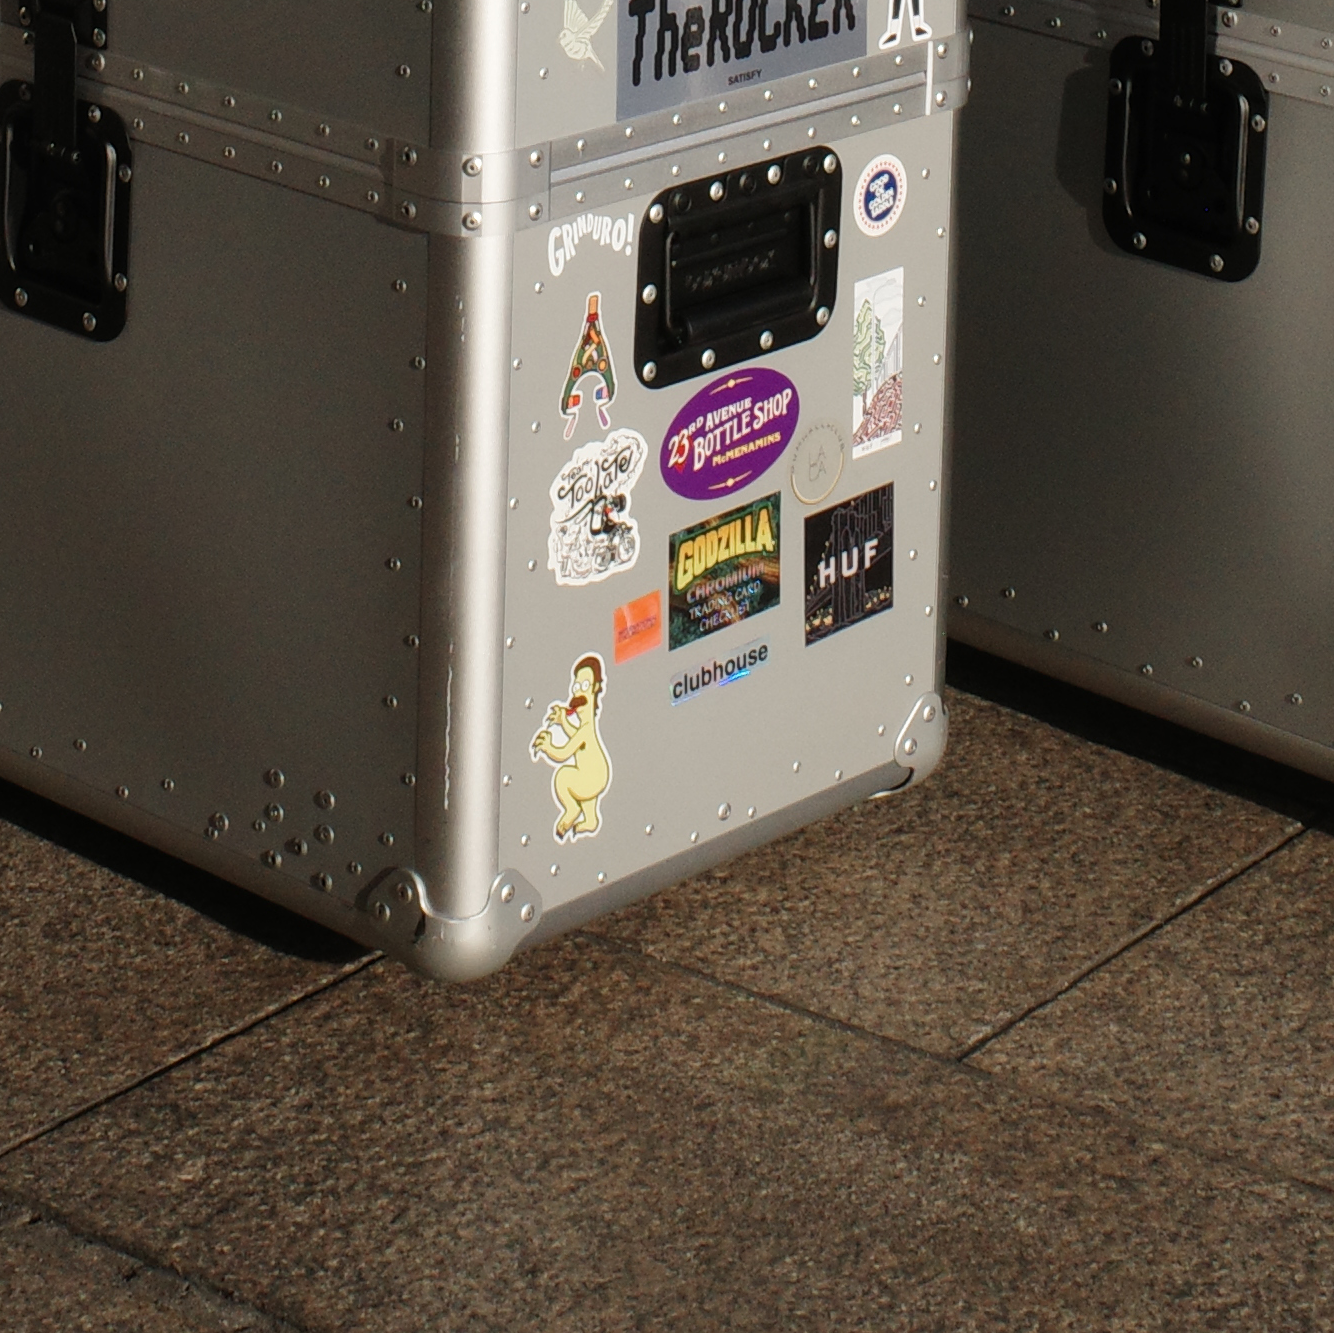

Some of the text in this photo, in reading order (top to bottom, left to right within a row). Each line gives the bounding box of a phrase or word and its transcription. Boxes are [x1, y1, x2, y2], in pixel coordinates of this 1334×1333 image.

[728, 69, 762, 85] SATISFY
[548, 212, 635, 277] GRINDURO!
[693, 410, 751, 471] BOTTLE
[753, 388, 793, 430] SHOP
[705, 397, 752, 431] AVENUE
[677, 508, 775, 590] GODZILLA
[818, 538, 879, 588] HUF
[686, 562, 766, 603] CHROMIUM
[689, 592, 733, 620] TRADING
[672, 644, 768, 699] clubhouse
